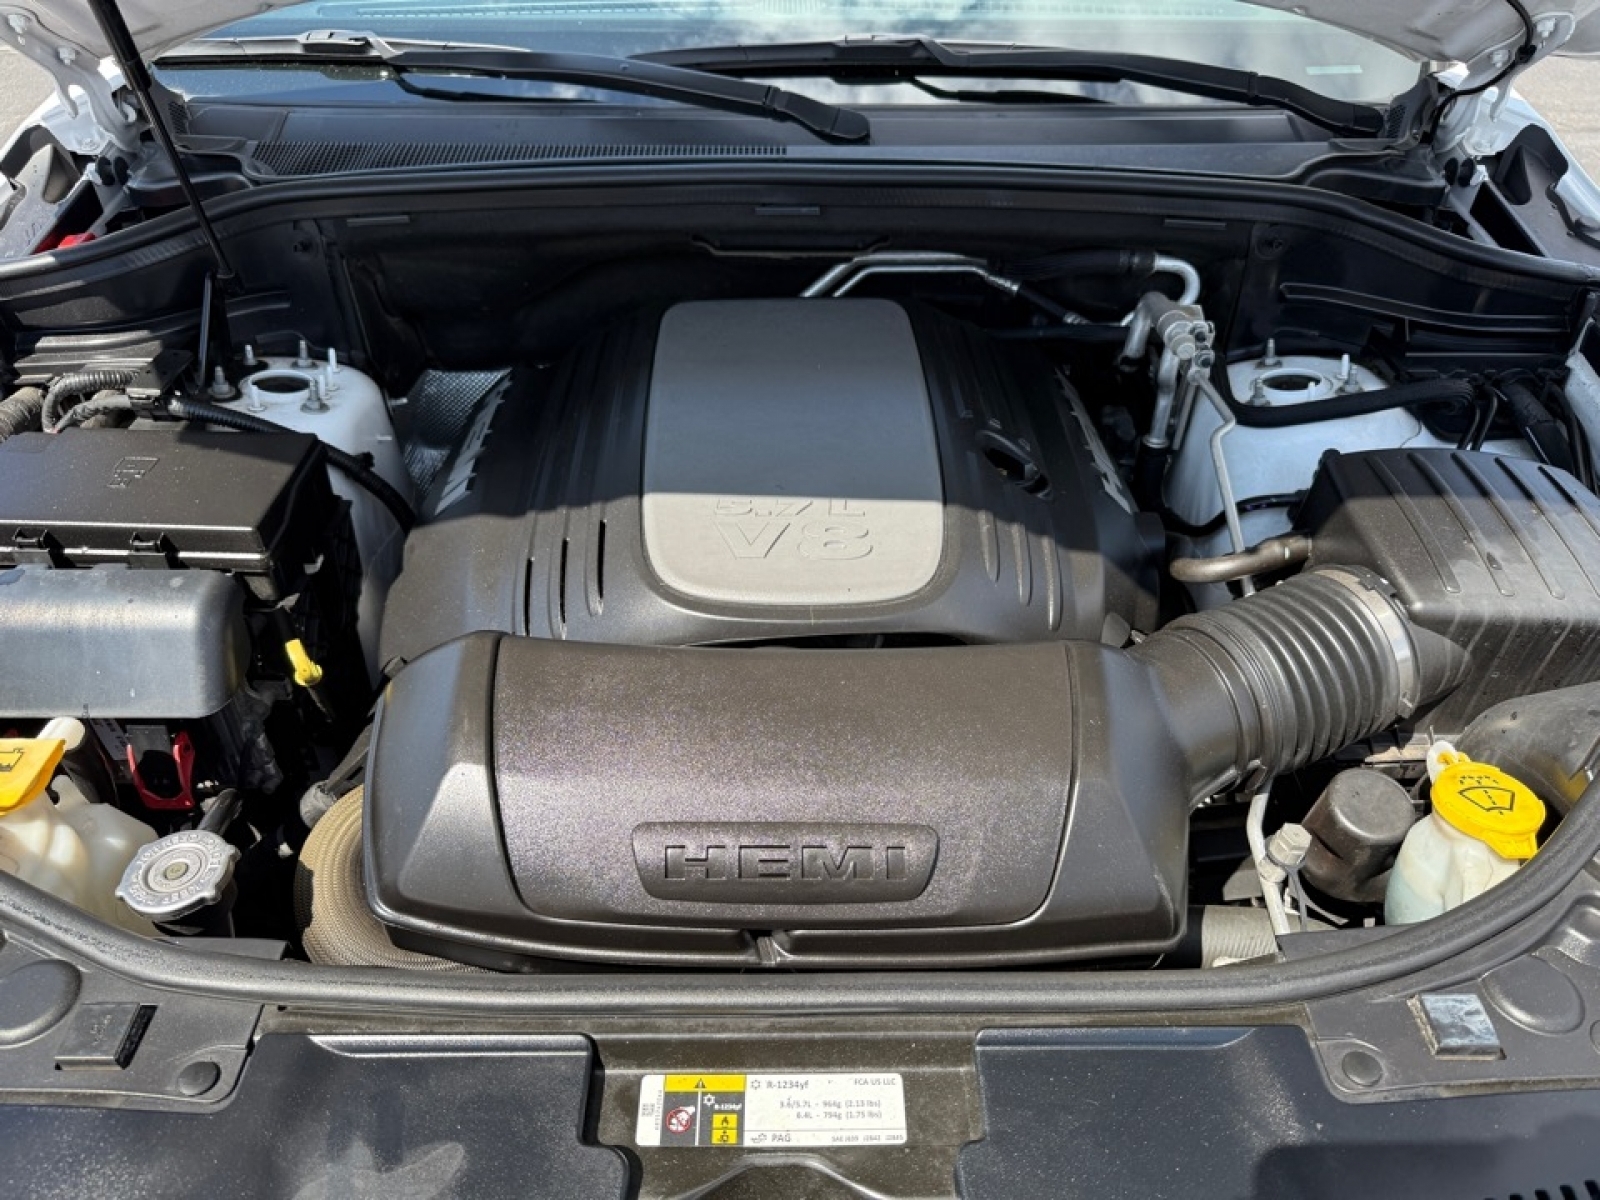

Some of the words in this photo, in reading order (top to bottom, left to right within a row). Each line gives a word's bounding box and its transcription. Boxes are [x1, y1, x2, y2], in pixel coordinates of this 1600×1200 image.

[709, 519, 875, 561] V8
[664, 844, 907, 881] HEMI
[766, 1080, 809, 1091] R-1234yf
[854, 1078, 869, 1086] FCA
[870, 1078, 882, 1086] US
[771, 1133, 791, 1143] PAG
